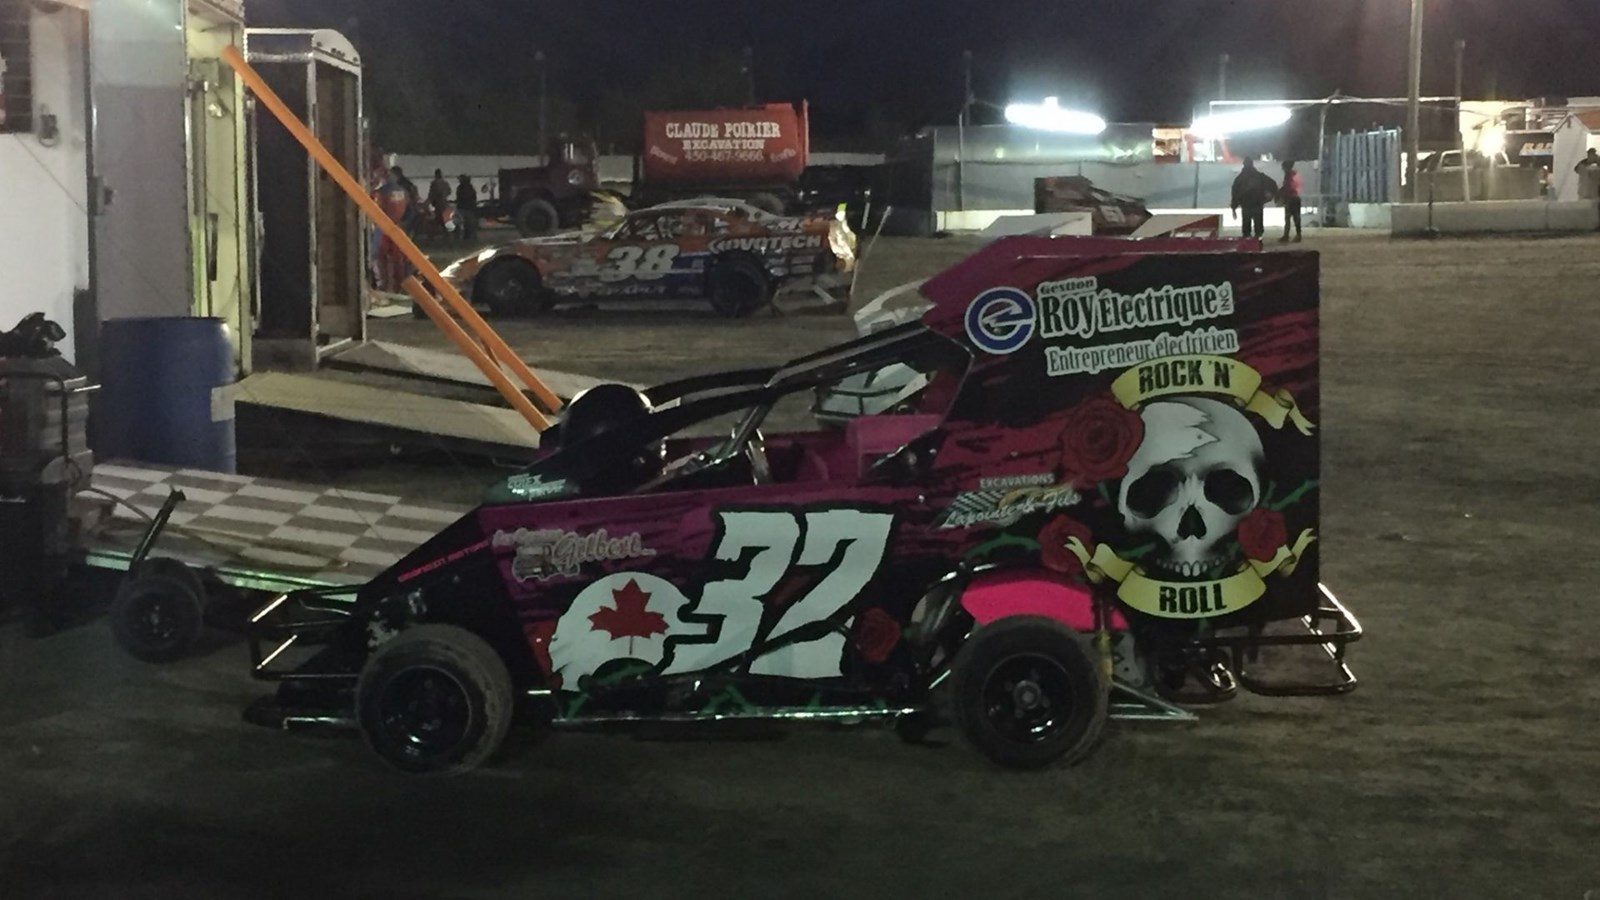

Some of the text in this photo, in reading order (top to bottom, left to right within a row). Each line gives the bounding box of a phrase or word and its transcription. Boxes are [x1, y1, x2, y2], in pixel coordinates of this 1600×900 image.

[666, 122, 781, 138] CLAUDE POIRIER
[682, 139, 766, 150] EXCAVATION
[600, 244, 680, 282] 38
[1040, 280, 1095, 294] Gestion
[1138, 360, 1204, 394] ROCK
[980, 474, 1055, 488] EXCAVATIONS
[1159, 583, 1228, 614] ROLL
